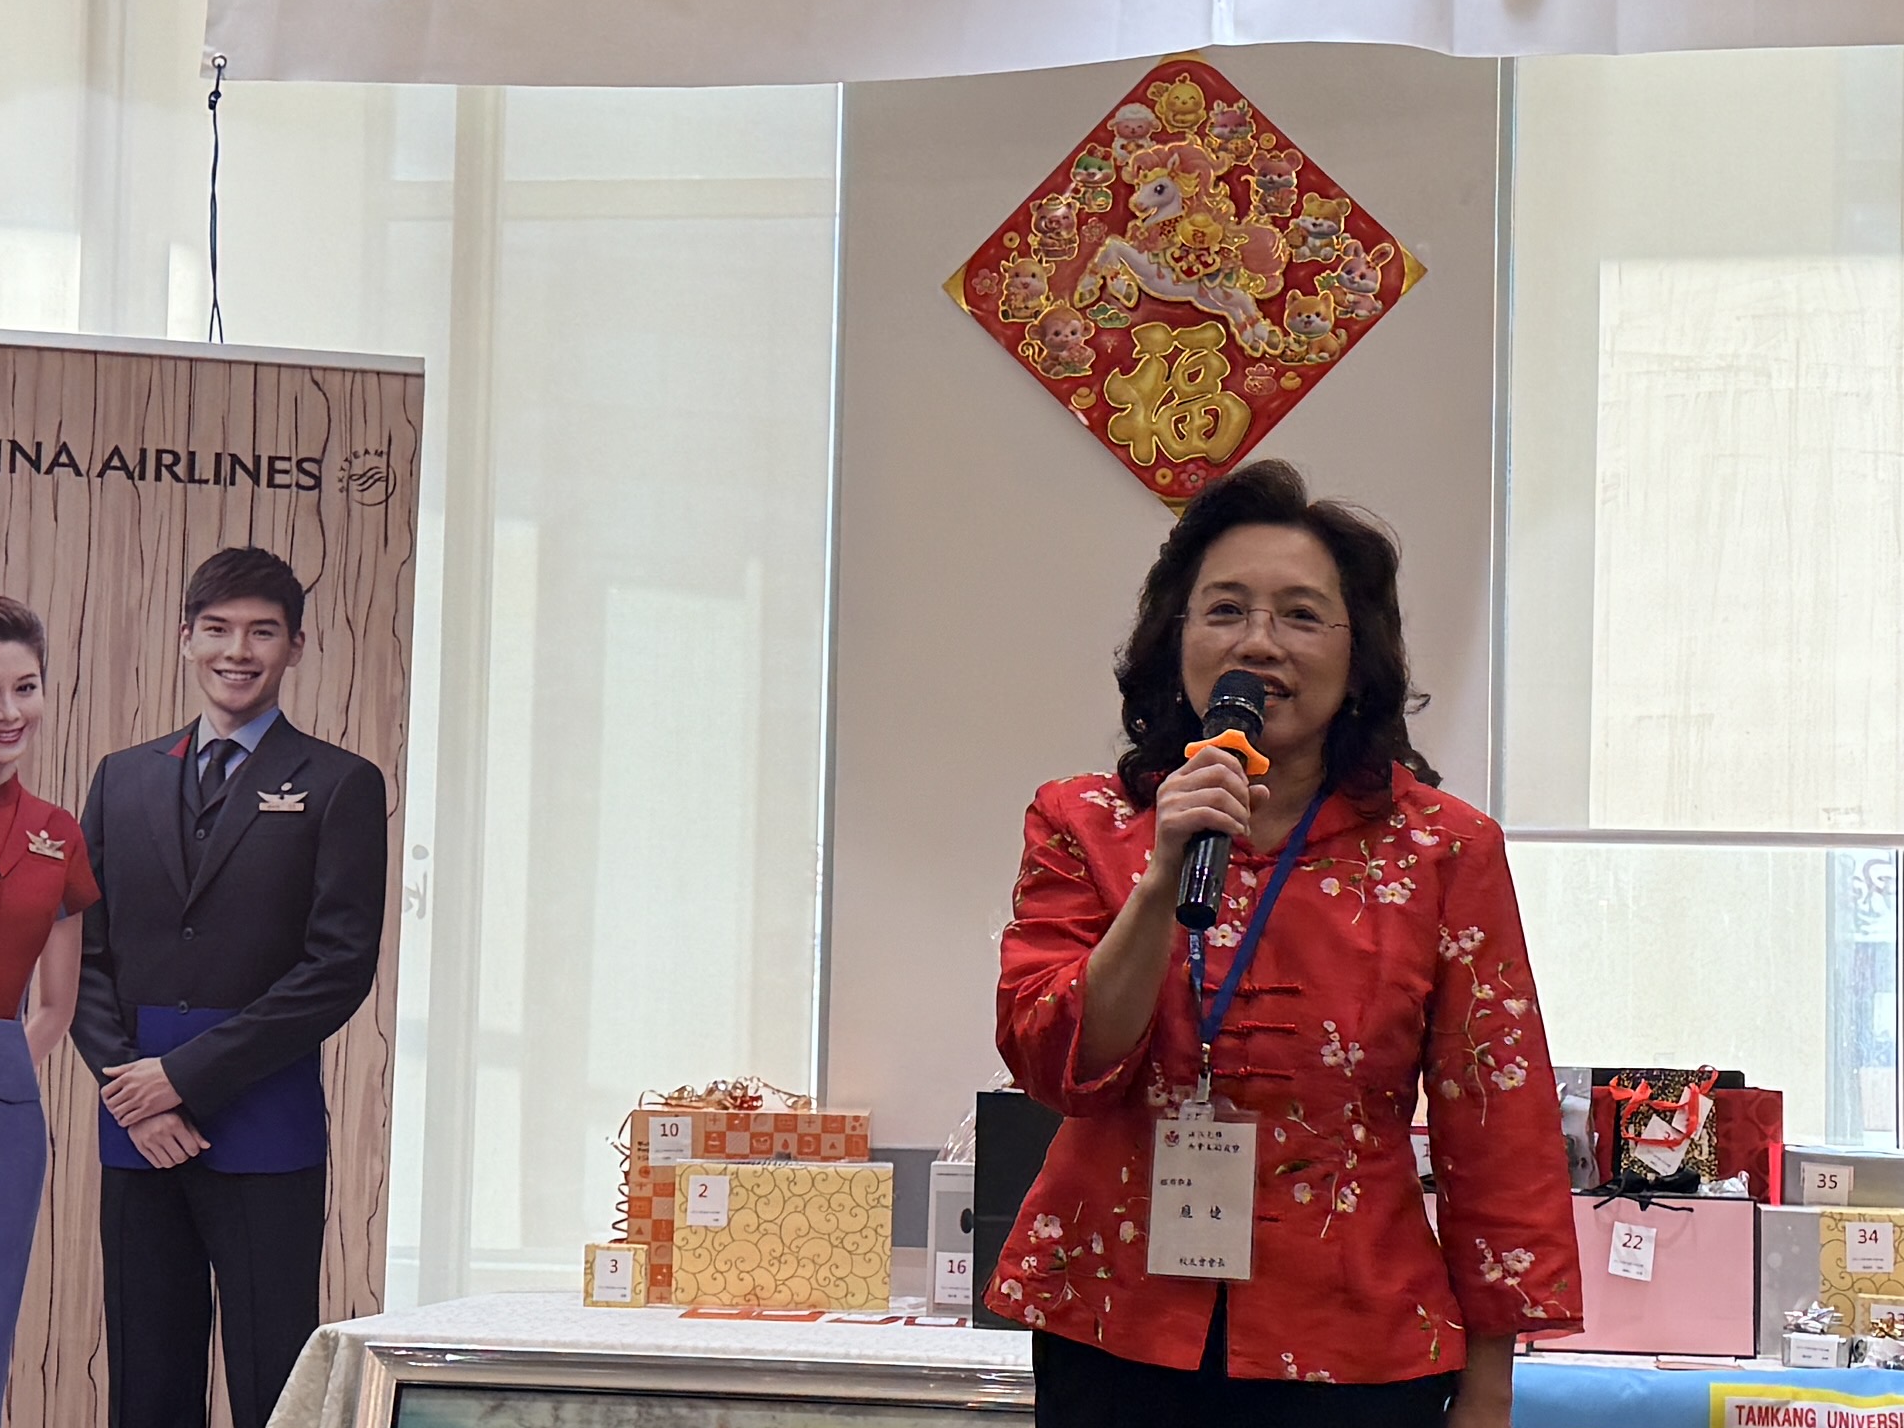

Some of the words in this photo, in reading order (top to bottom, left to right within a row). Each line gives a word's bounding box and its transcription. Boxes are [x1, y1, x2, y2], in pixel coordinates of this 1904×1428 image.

[1104, 321, 1253, 467] 福
[96, 443, 323, 493] AIRLINES
[660, 1123, 679, 1137] 10
[1816, 1174, 1838, 1189] 35
[698, 1183, 708, 1198] 2
[1621, 1234, 1643, 1250] 22
[1857, 1229, 1879, 1245] 34
[609, 1259, 618, 1274] 3
[947, 1259, 967, 1274] 16
[1735, 1404, 1817, 1428] TAMKANG
